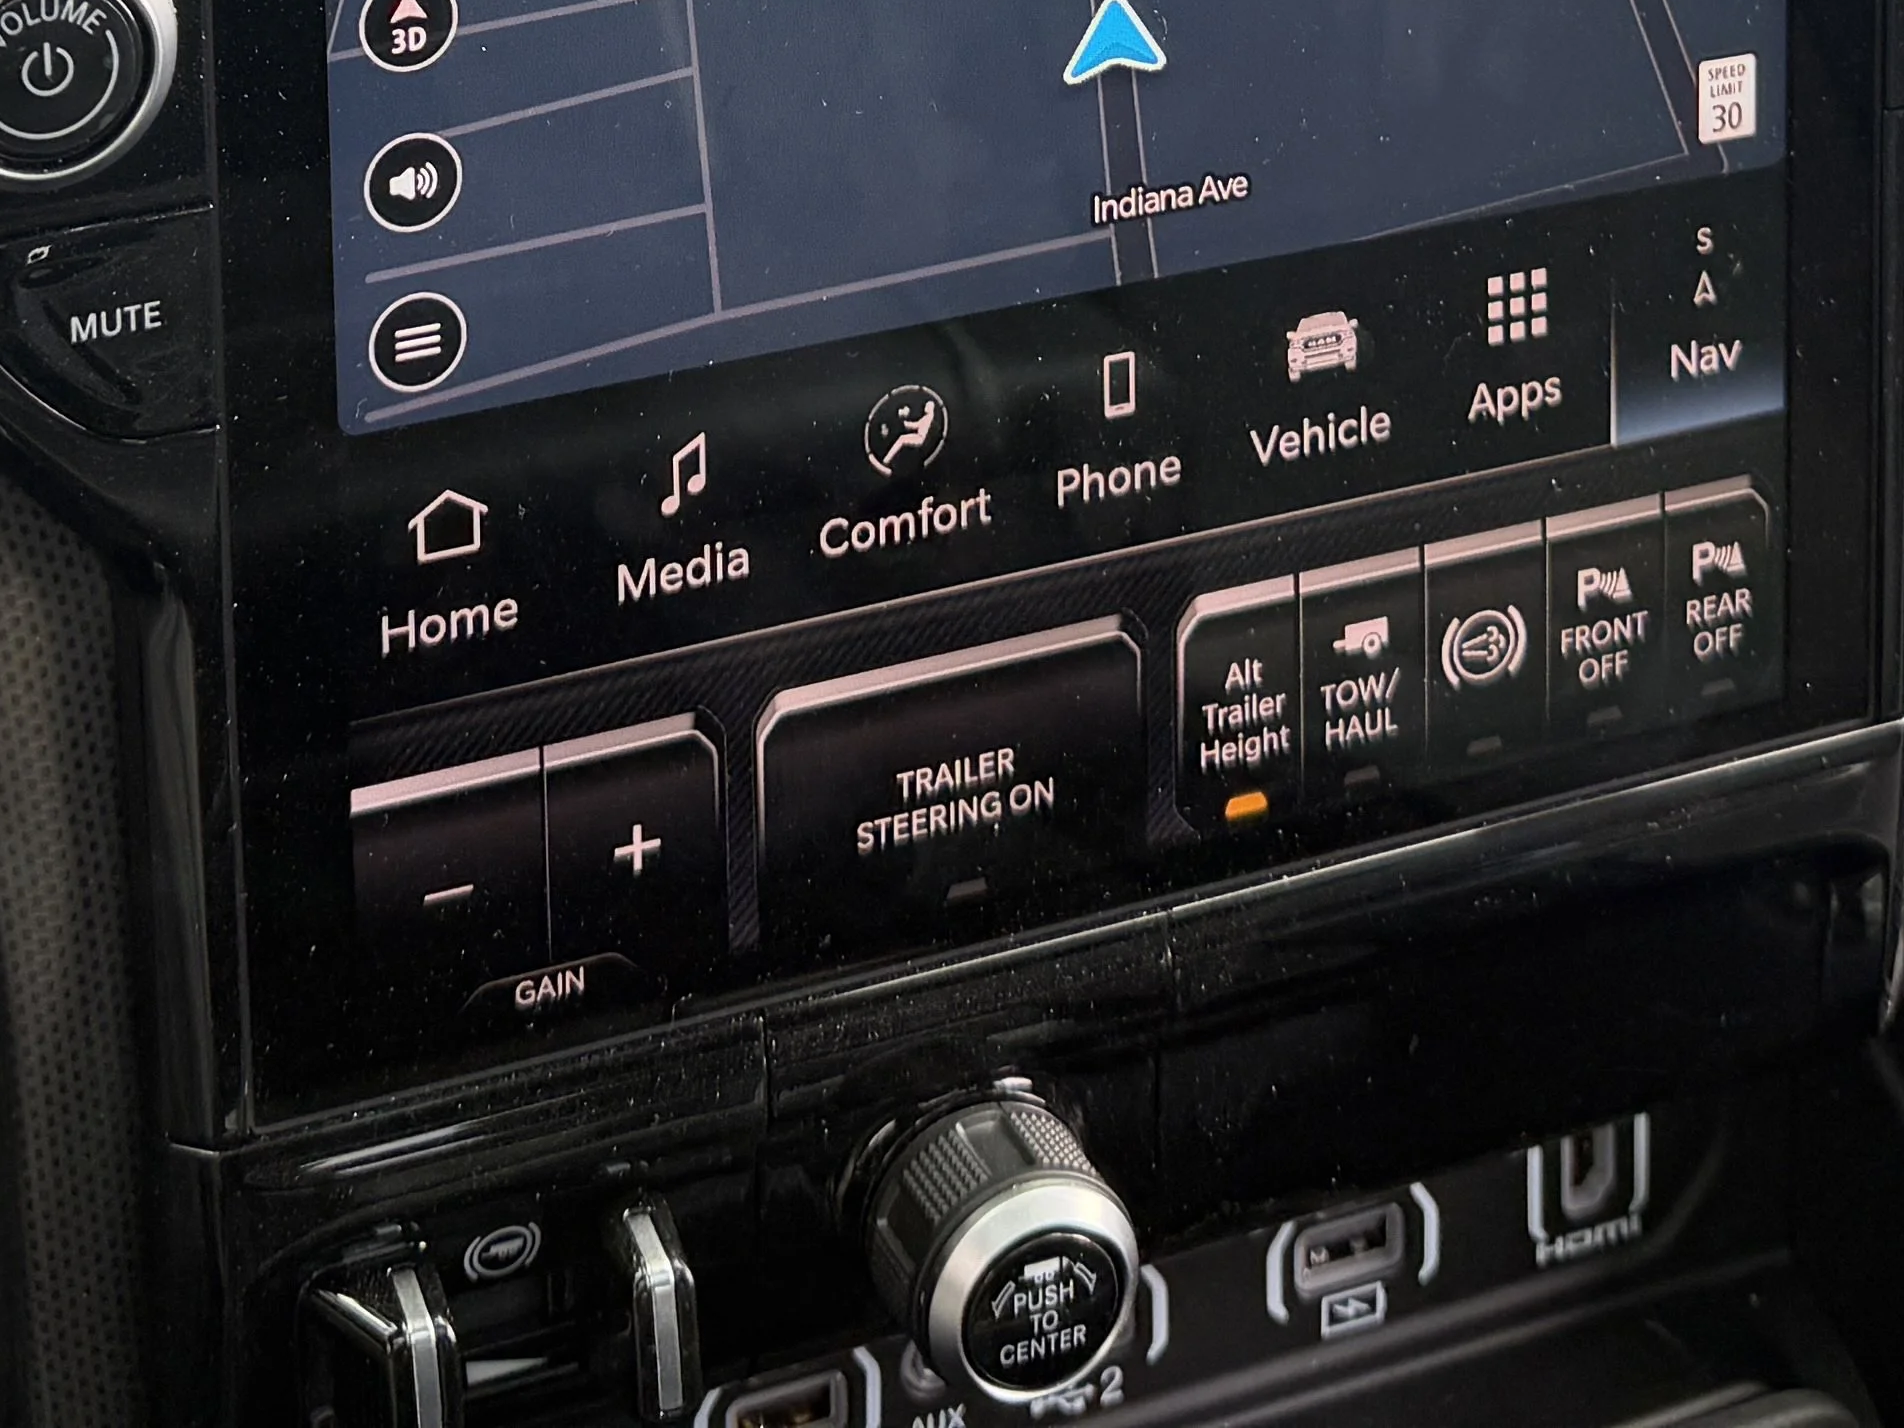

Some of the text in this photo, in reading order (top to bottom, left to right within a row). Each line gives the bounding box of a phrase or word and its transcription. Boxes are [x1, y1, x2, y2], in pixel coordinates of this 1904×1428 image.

[391, 26, 427, 55] 3D
[1707, 63, 1746, 82] SPEED
[1710, 81, 1744, 99] LIMIT
[1712, 101, 1744, 133] 30
[1093, 174, 1249, 224] Indiana Ave
[69, 301, 163, 346] MUTE
[1670, 337, 1743, 383] Nav
[1468, 372, 1563, 425] Apps
[1249, 404, 1392, 468] Vehicle
[1057, 455, 1182, 508] Phone
[819, 487, 993, 558] Comfort
[616, 542, 751, 606] Media
[380, 594, 519, 659] Home
[1686, 588, 1754, 626] REAR
[1561, 610, 1649, 657] FRONT
[1694, 623, 1744, 661] OFF
[1226, 657, 1264, 693] Alt
[1321, 667, 1399, 715] TOW/
[1579, 651, 1629, 691] OFF
[1202, 691, 1286, 736] Trailer
[1326, 706, 1398, 748] HAUL
[1200, 724, 1291, 772] Height
[897, 747, 1016, 802] TRAILER
[856, 777, 1056, 854] STEERING ON
[515, 966, 586, 1012] GAIN
[1013, 1280, 1075, 1317] PUSH
[1029, 1310, 1060, 1334] TO
[1000, 1324, 1087, 1367] CENTER
[1100, 1365, 1124, 1408] 2
